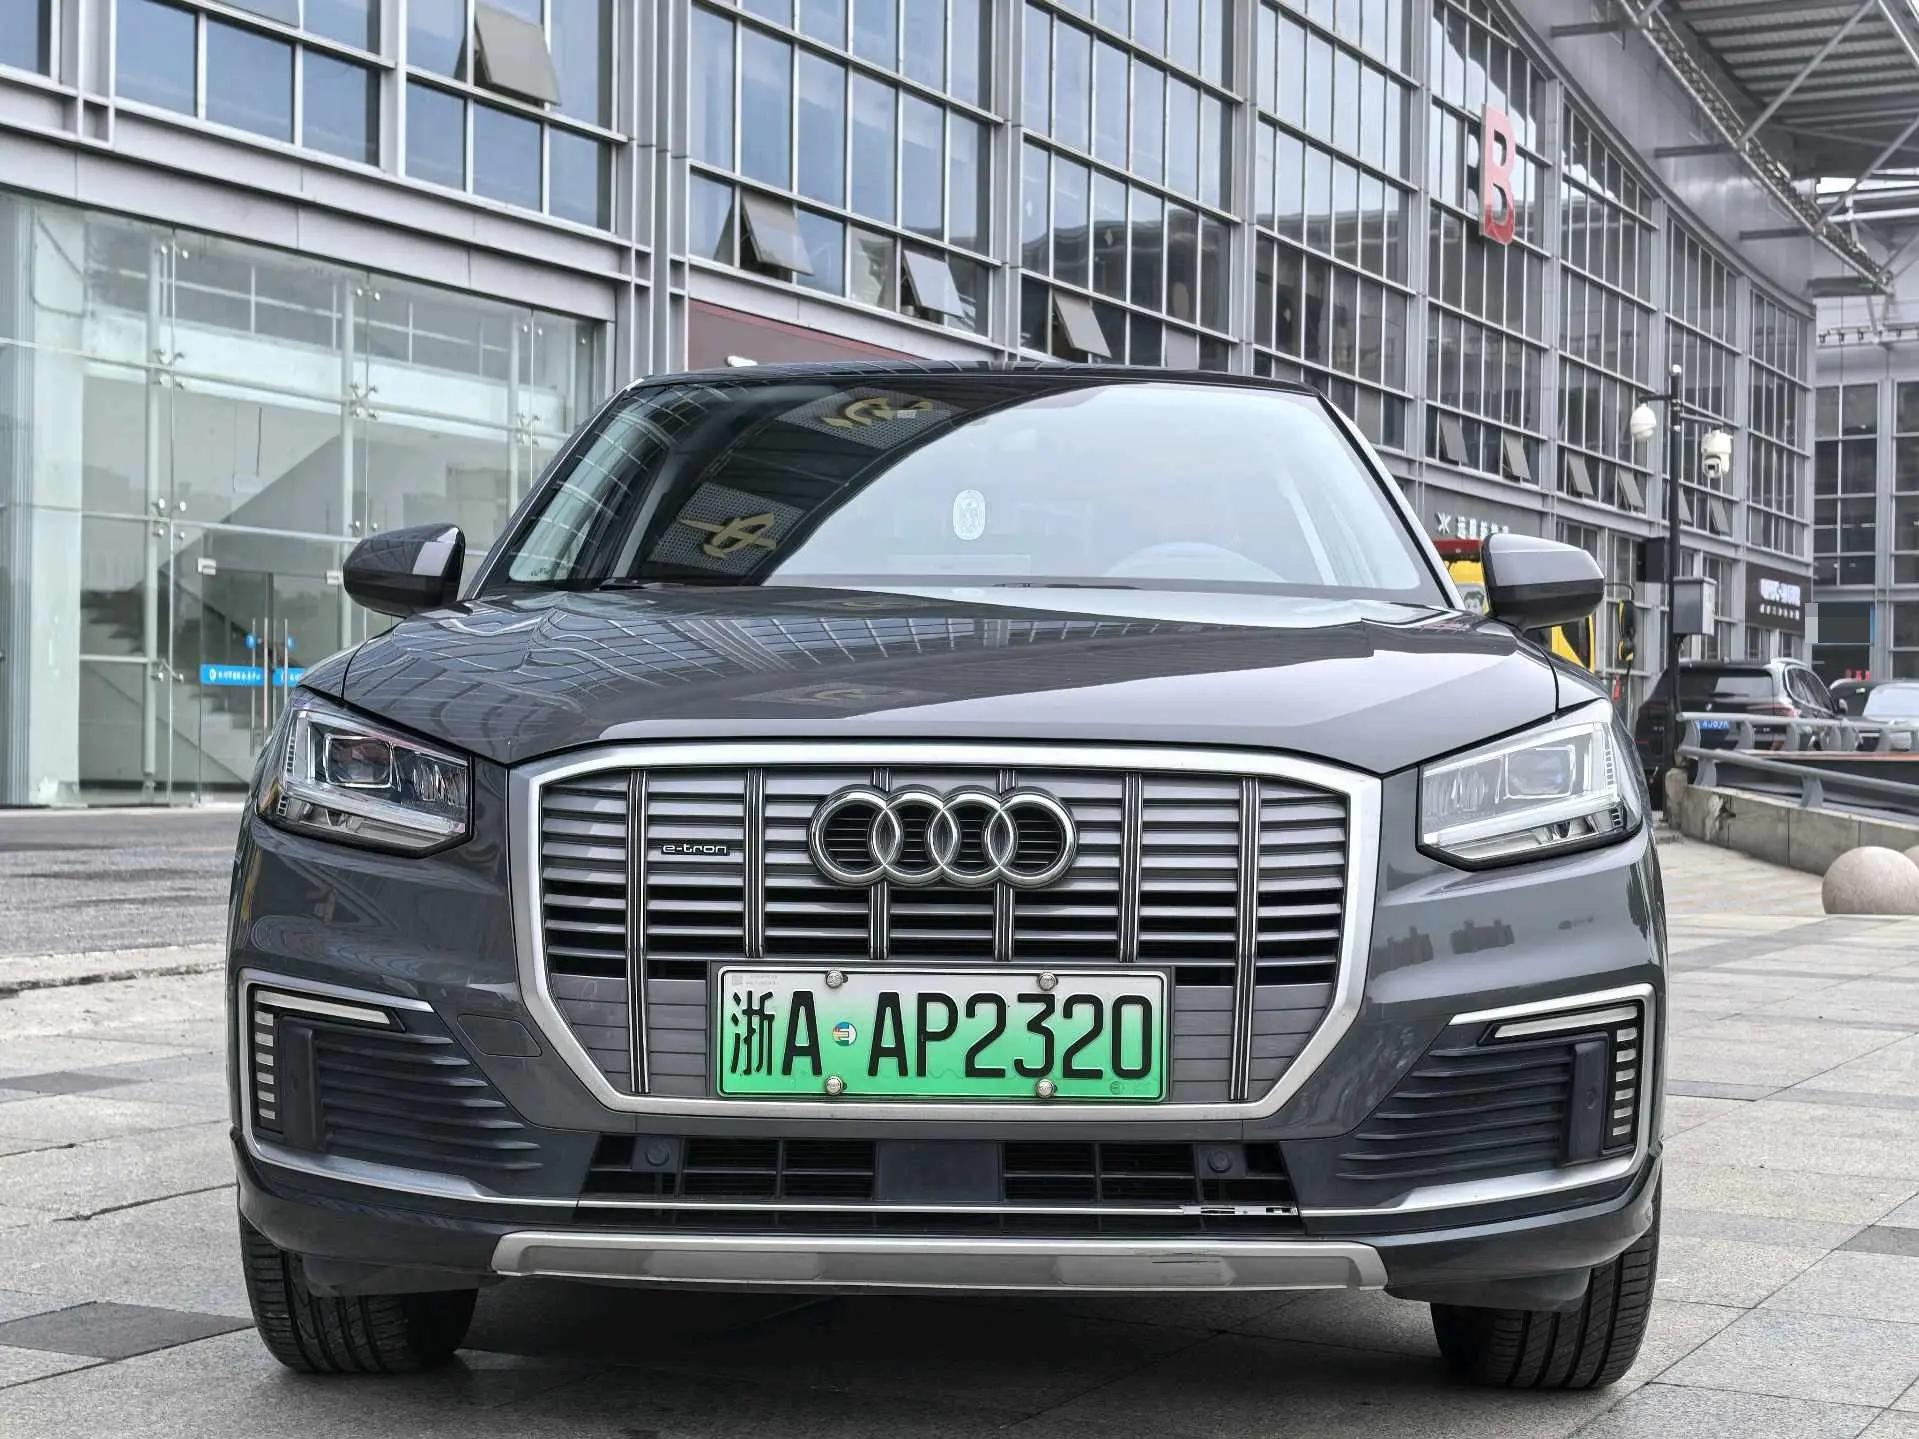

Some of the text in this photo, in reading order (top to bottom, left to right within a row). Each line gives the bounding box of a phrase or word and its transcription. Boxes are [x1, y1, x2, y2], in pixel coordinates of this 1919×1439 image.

[1480, 104, 1515, 244] B
[662, 843, 727, 854] e-tron
[867, 991, 1153, 1079] AP2320
